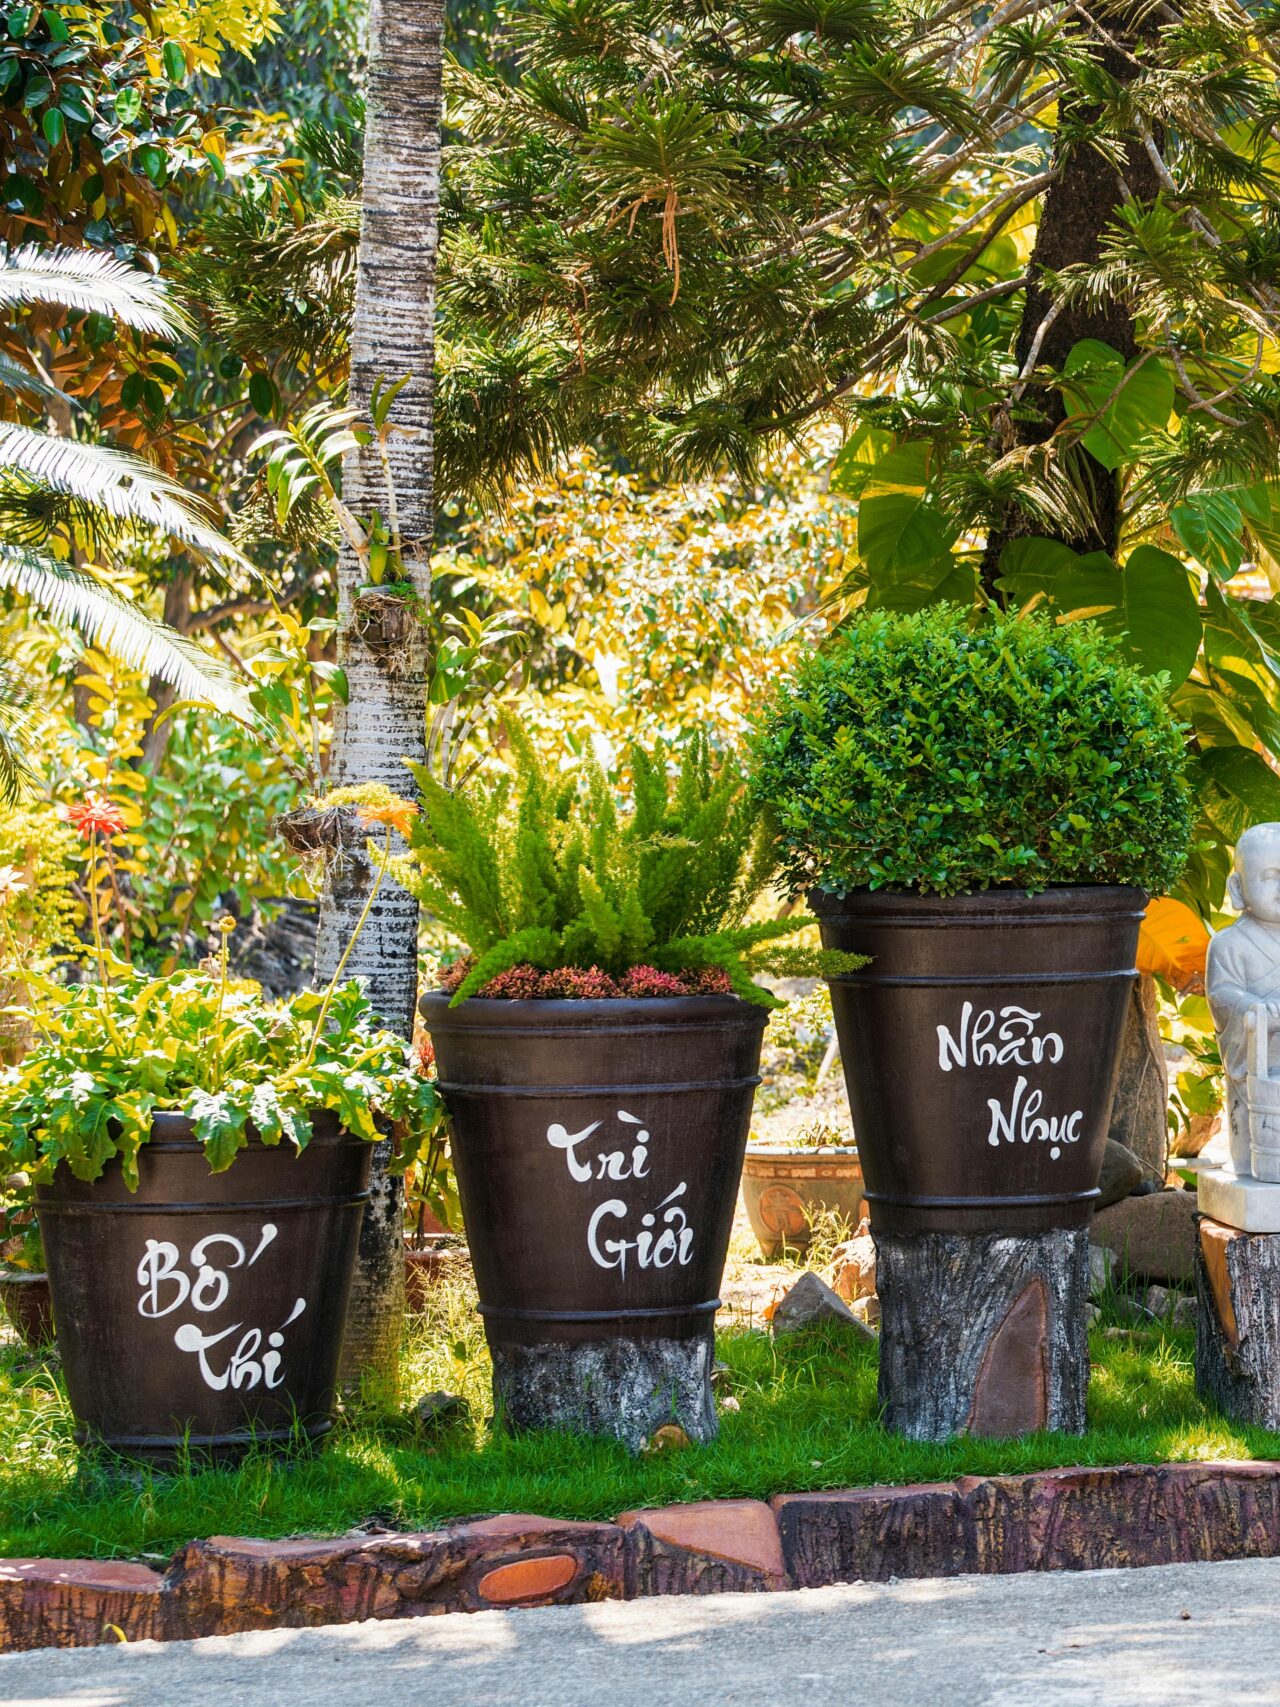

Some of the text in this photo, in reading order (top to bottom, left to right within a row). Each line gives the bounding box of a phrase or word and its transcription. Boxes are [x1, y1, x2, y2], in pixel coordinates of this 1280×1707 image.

[936, 1001, 1064, 1072] Nhẫn
[547, 1111, 651, 1183] Trì
[987, 1075, 1083, 1161] Nhục
[136, 1223, 278, 1318] Bố
[174, 1297, 307, 1391] Thí
